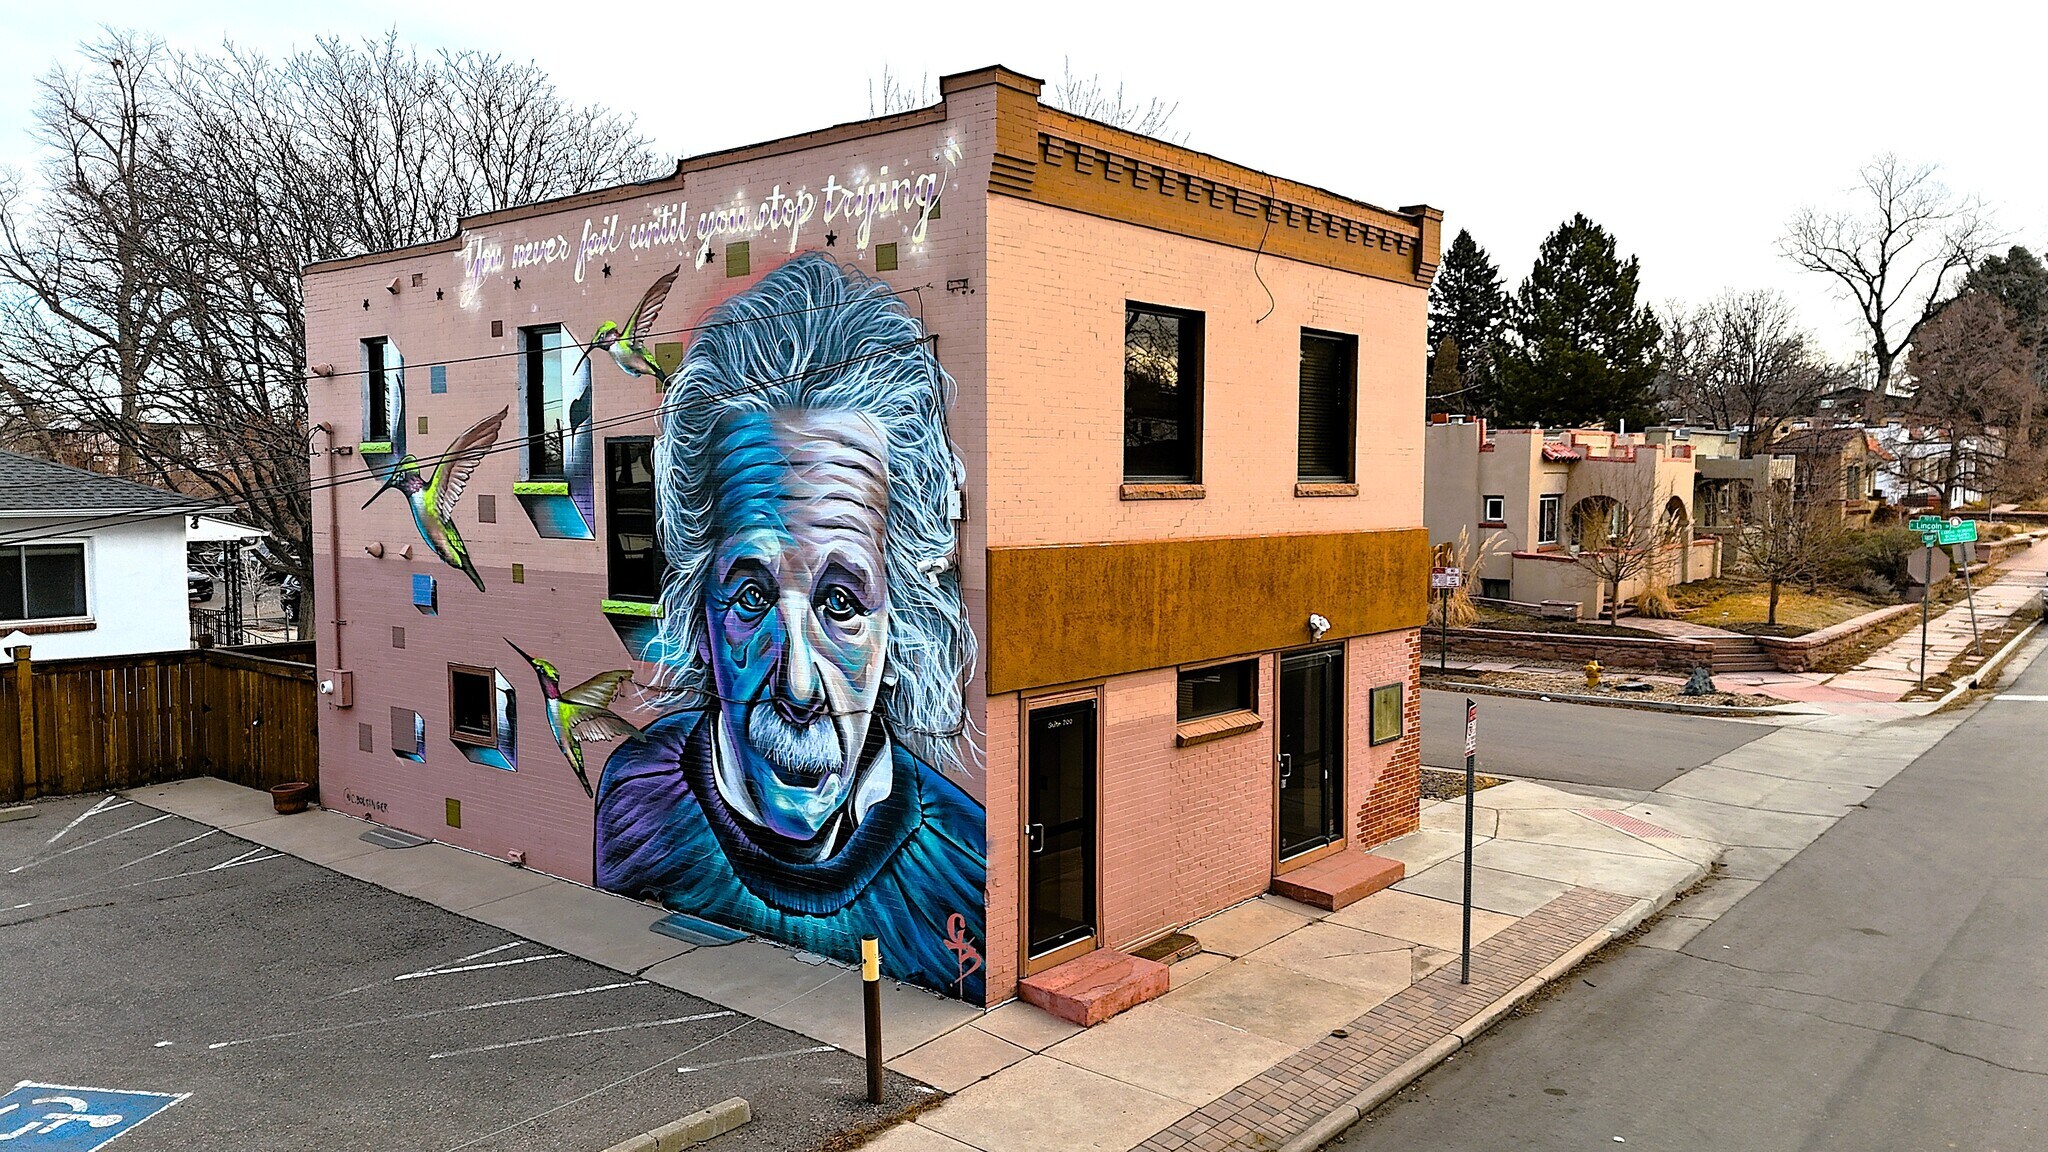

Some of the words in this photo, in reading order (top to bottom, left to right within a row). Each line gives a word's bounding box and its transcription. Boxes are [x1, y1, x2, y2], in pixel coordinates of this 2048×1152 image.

[512, 234, 571, 269] never
[574, 214, 624, 284] fail
[629, 201, 692, 250] until
[695, 205, 750, 271] you
[753, 184, 818, 253] stop
[1916, 522, 1942, 530] Lincoln
